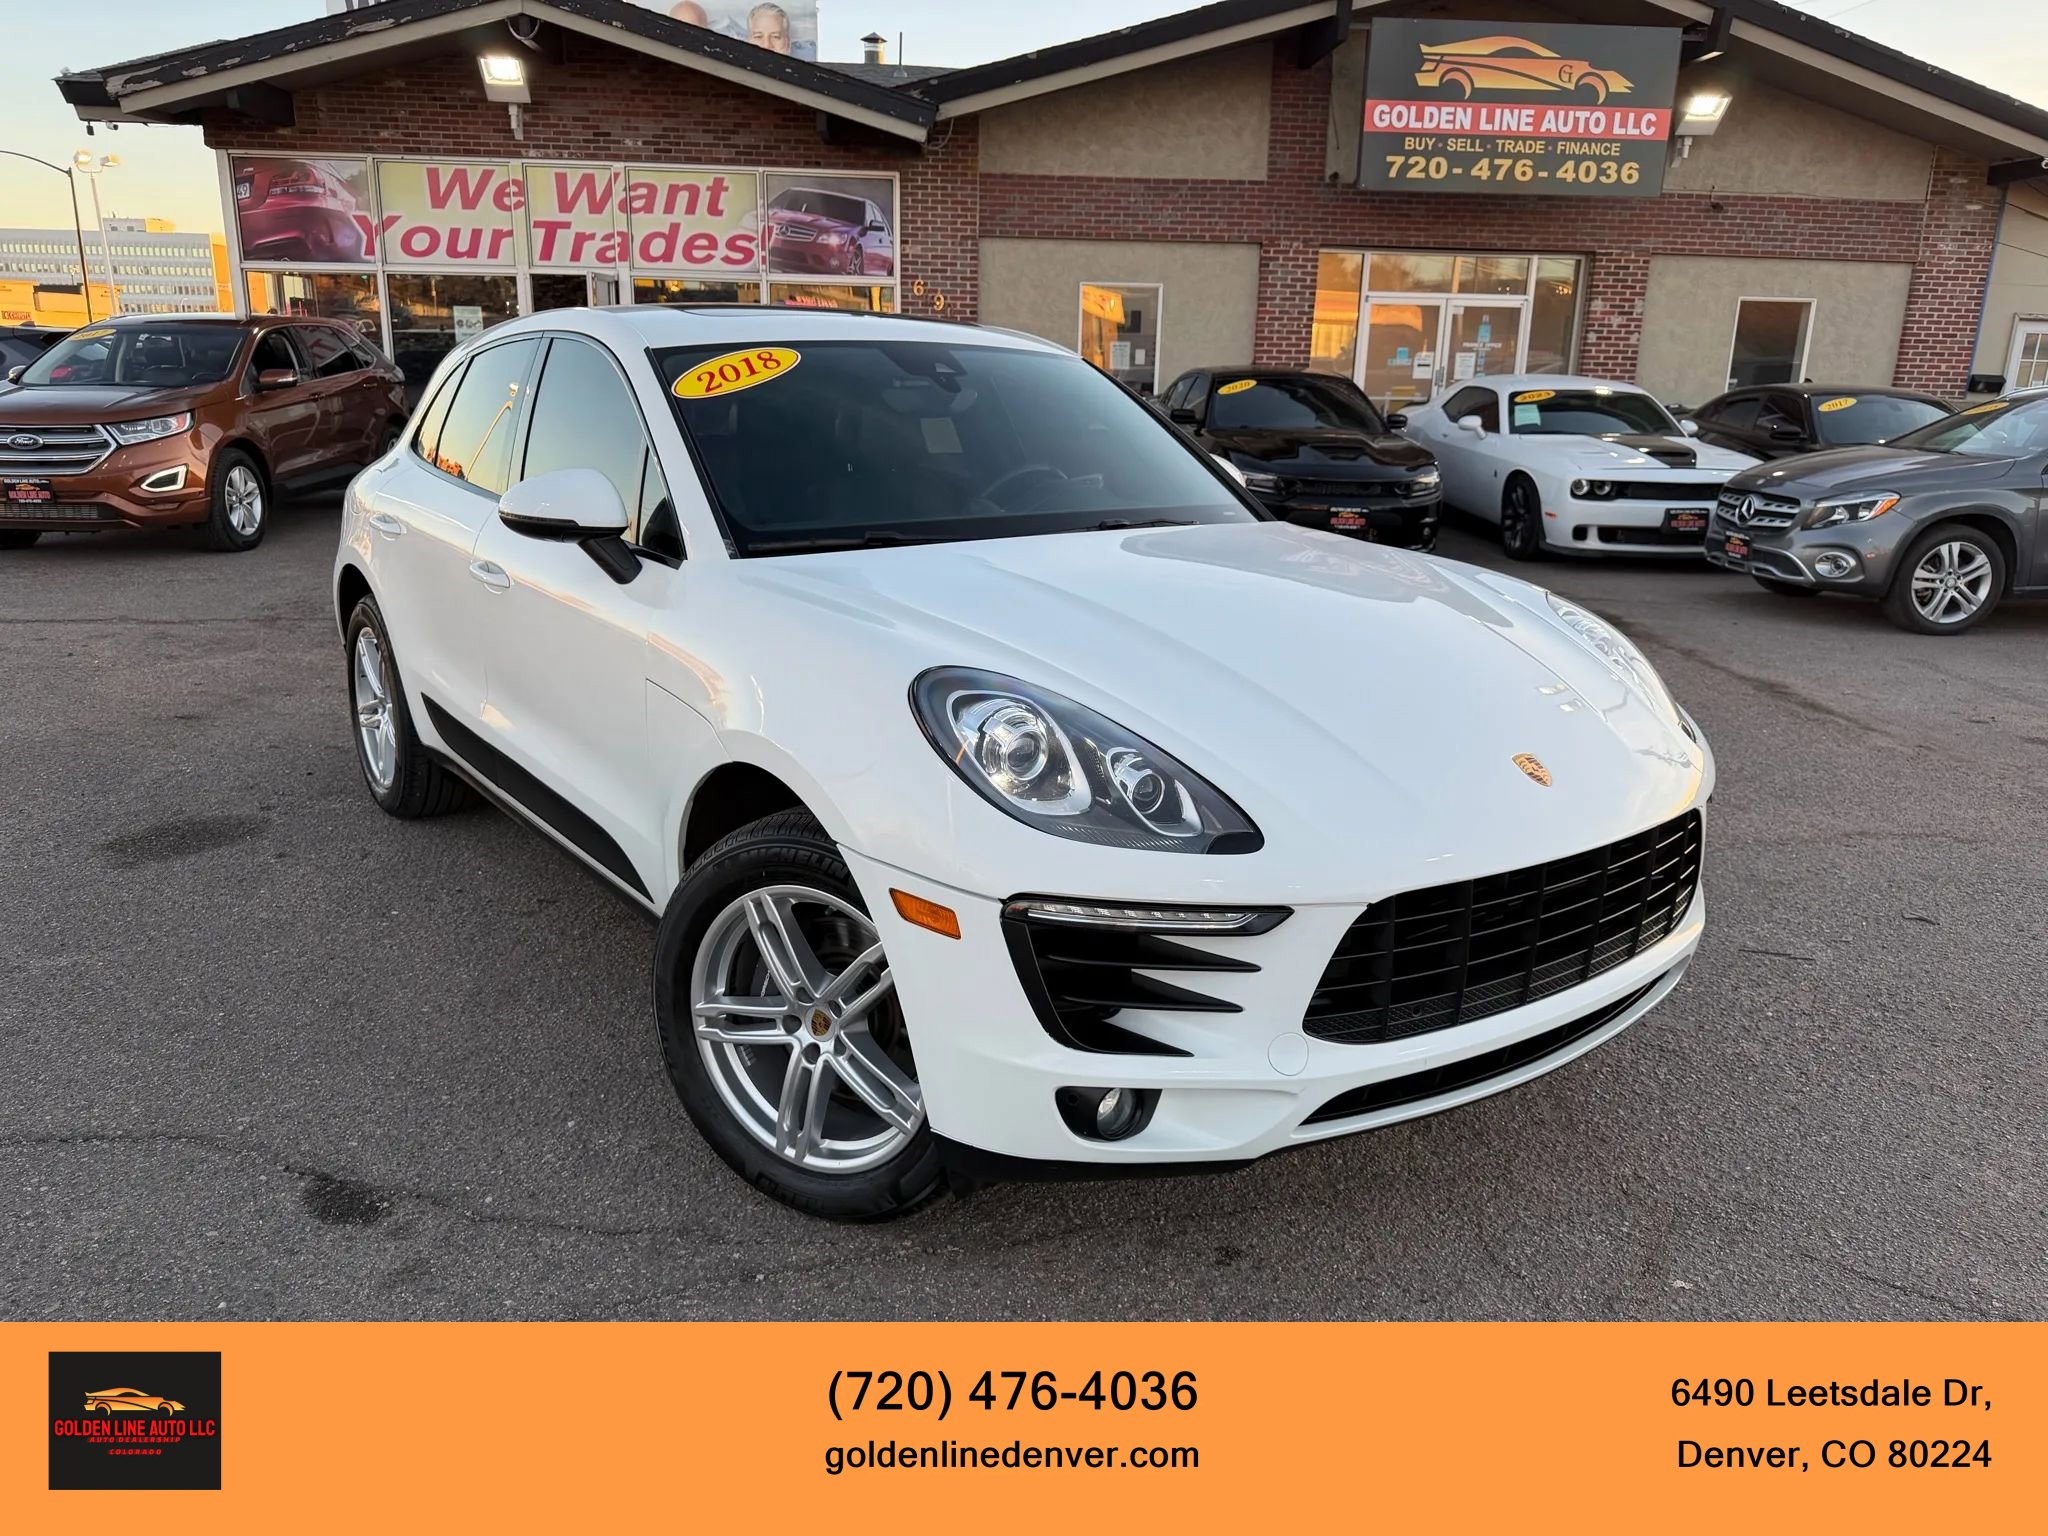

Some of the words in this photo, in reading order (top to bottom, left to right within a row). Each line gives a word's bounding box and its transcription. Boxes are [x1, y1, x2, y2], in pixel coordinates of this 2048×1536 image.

[1558, 64, 1573, 84] G
[1373, 104, 1470, 131] GOLDEN
[1479, 107, 1534, 132] LINE
[1540, 110, 1606, 135] AUTO
[1613, 112, 1657, 136] LLC
[1404, 137, 1436, 150] BUY
[1447, 138, 1484, 152] SELL
[1496, 139, 1545, 154] TRADE
[1557, 141, 1621, 156] FINANCE
[426, 167, 525, 212] We
[554, 172, 729, 217] Want
[352, 215, 514, 260] Your
[532, 220, 774, 266] Trades!
[913, 280, 924, 296] 6
[696, 351, 782, 393] 2018
